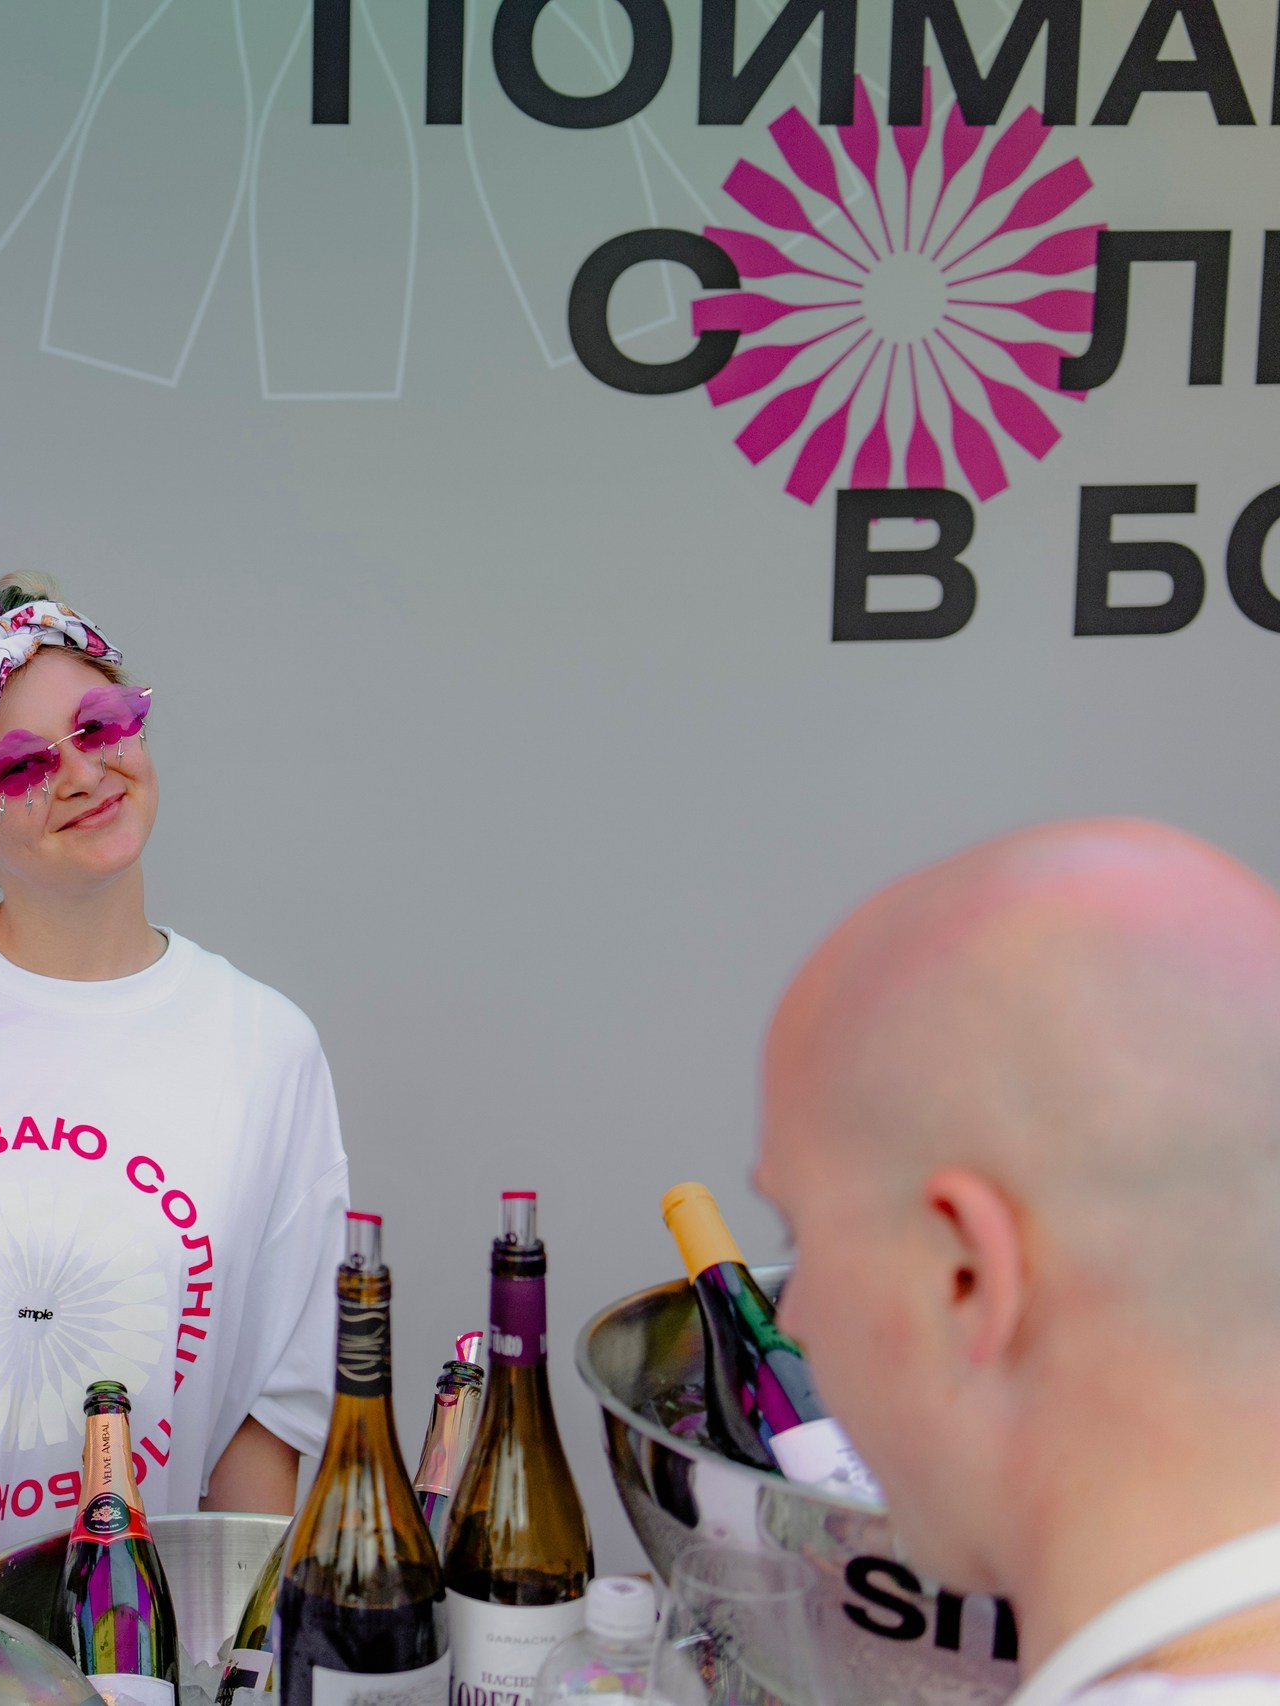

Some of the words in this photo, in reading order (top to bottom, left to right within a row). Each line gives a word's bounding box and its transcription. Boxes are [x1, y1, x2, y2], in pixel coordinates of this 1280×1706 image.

[831, 486, 978, 642] В
[125, 1155, 214, 1397] СОЛНЦ
[18, 1306, 53, 1322] simple
[101, 1422, 111, 1454] AMBAL
[103, 1455, 113, 1486] VEUVE
[485, 1632, 557, 1646] GARNACHA
